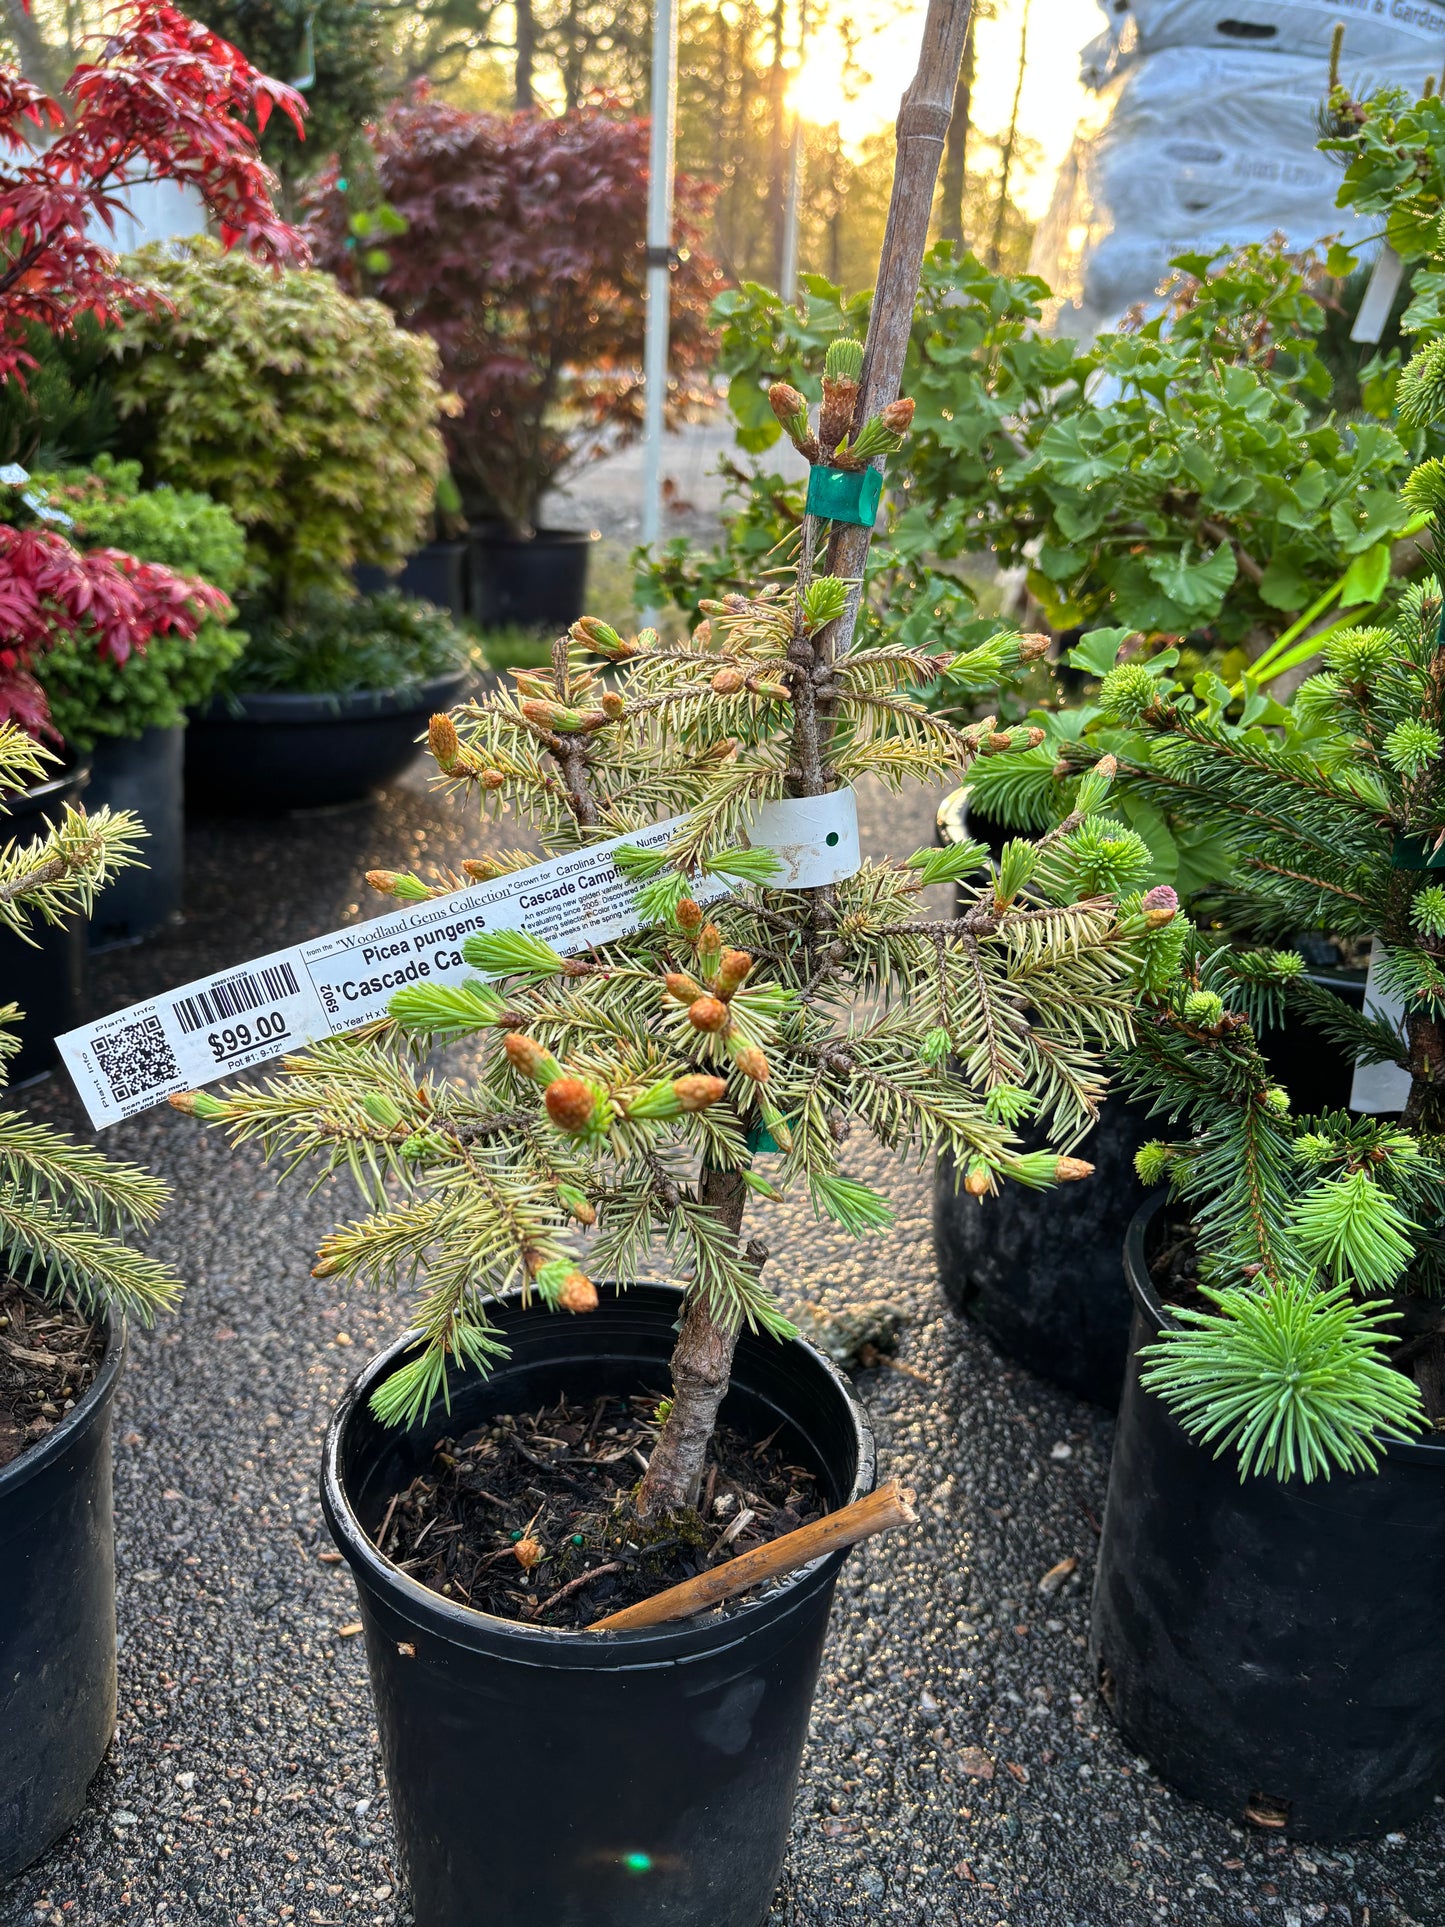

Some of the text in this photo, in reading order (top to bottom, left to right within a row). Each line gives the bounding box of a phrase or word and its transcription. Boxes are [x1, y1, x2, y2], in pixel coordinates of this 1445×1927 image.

[306, 945, 322, 957] from
[322, 943, 334, 952] the
[336, 918, 408, 949] "Woodland
[410, 909, 447, 926] Gems
[449, 883, 513, 914] Collection"
[514, 876, 539, 889] Grown
[540, 872, 551, 881] for
[556, 858, 596, 876] Carolina
[636, 832, 671, 848] Nursery
[519, 882, 576, 909] Cascade
[524, 913, 534, 921] An
[536, 904, 562, 917] exciting
[563, 899, 577, 907] new
[578, 889, 600, 904] golden
[602, 883, 623, 895] variety
[527, 913, 562, 929] evaluating
[563, 907, 581, 917] since
[602, 886, 639, 903] Discovered
[531, 924, 559, 936] seedling
[592, 905, 610, 916] Color
[559, 926, 581, 937] weeks
[590, 918, 601, 927] the
[602, 911, 622, 923] spring
[621, 925, 637, 937] Full
[637, 920, 653, 931] Sun
[362, 915, 486, 965] Picea pungens
[335, 960, 431, 1001] 'Cascade
[320, 984, 340, 1014] 5902
[95, 1004, 156, 1032] Plant Info
[332, 1024, 343, 1032] 10
[343, 1016, 364, 1030] Year
[365, 1012, 373, 1021] H
[208, 1011, 287, 1058] $99.00
[228, 1058, 244, 1069] Pot
[82, 1052, 110, 1108] Plant Info
[121, 1081, 188, 1112] Scan me for more
[123, 1108, 138, 1117] info
[140, 1101, 154, 1110] and
